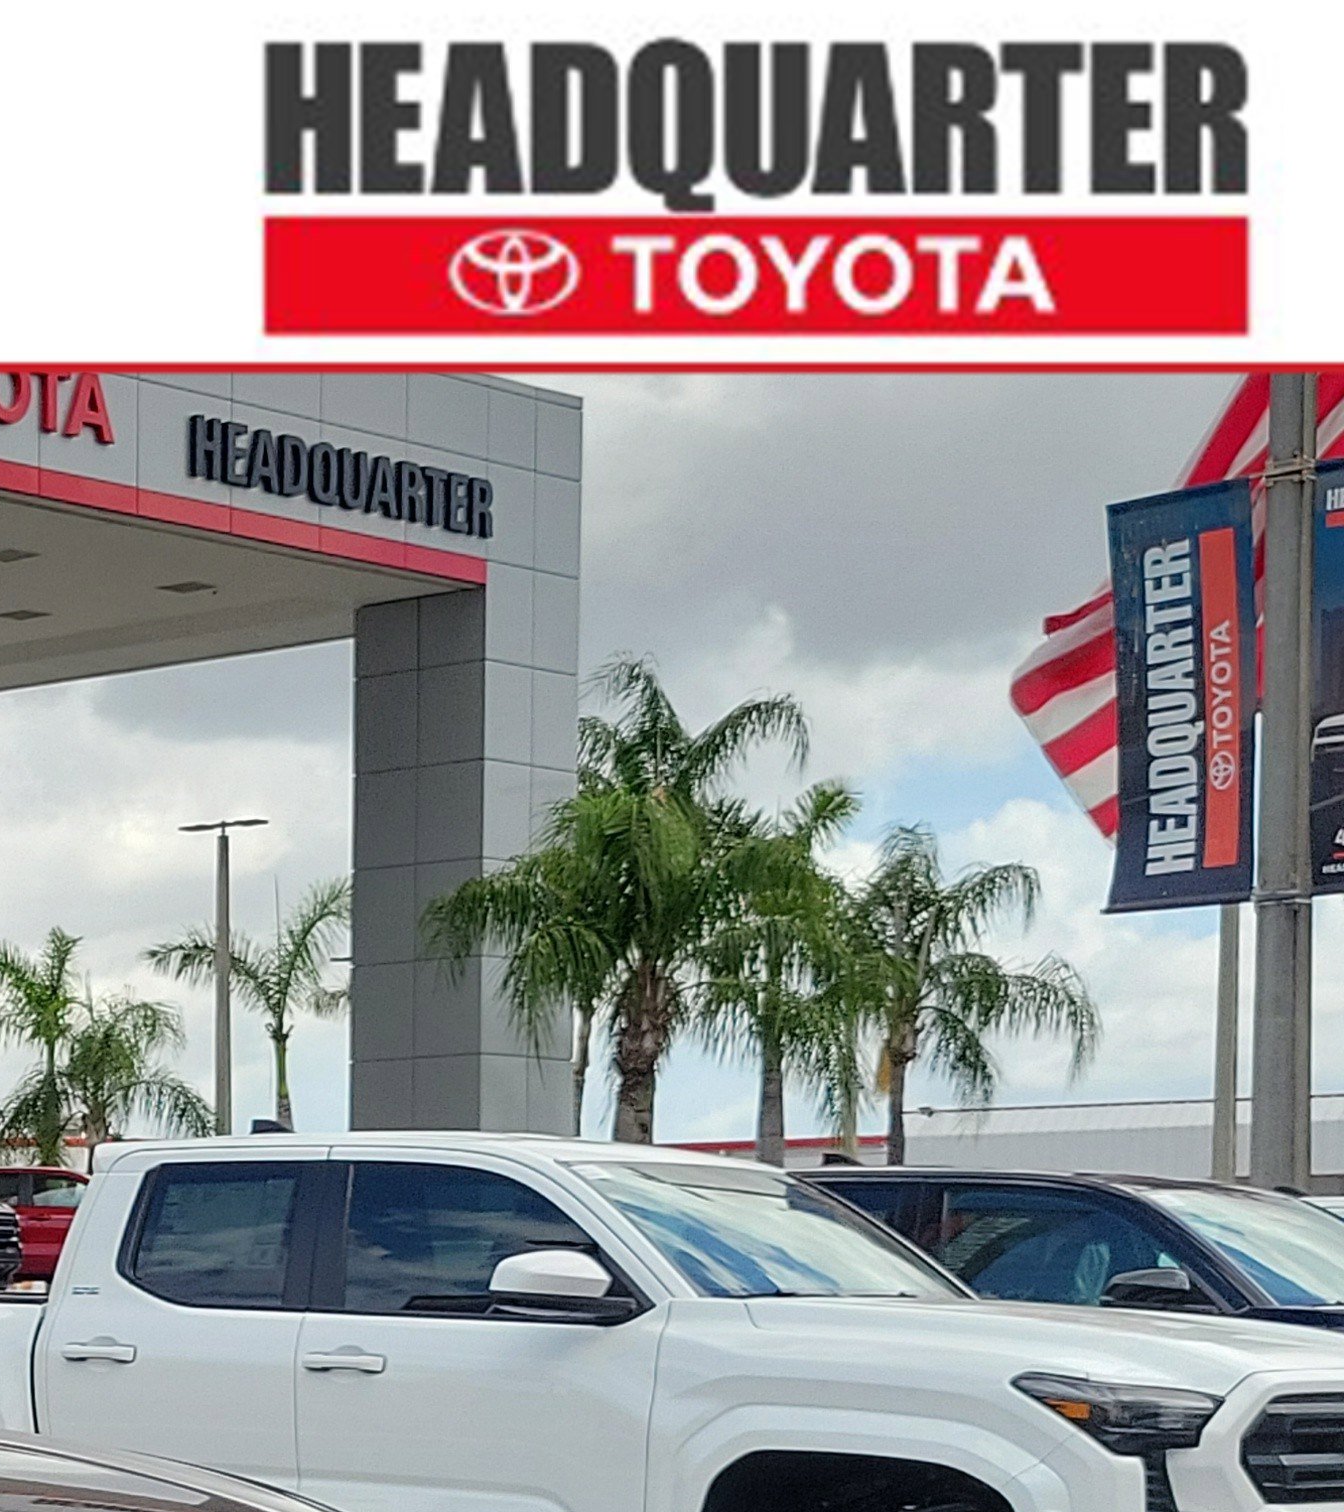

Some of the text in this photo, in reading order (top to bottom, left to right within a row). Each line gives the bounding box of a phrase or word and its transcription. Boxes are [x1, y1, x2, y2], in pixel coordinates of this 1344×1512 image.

[188, 414, 494, 538] HEADQUARTER
[1143, 538, 1205, 876] HEADQUARTER
[1210, 619, 1233, 749] TOYOTA
